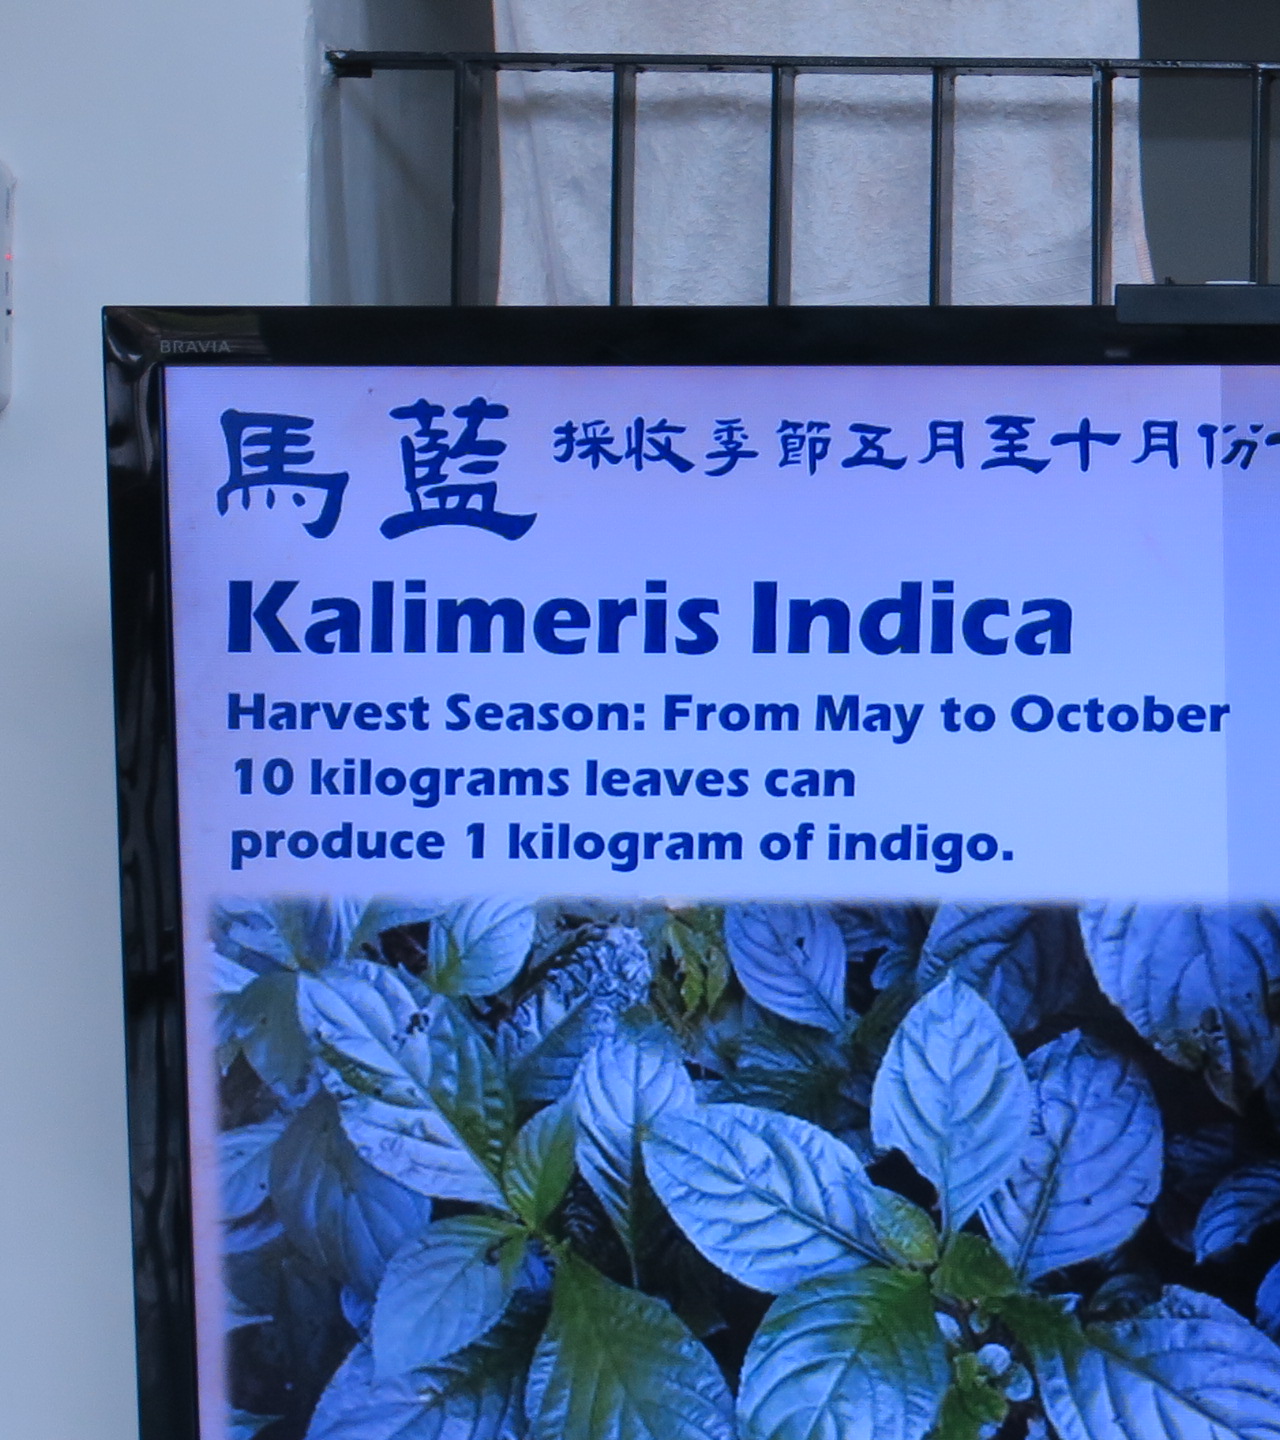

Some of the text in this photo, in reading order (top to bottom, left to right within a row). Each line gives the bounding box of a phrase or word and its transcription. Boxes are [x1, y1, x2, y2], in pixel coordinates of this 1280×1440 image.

[159, 339, 232, 354] BRAVIA
[216, 394, 540, 542] 馬藍
[226, 580, 1074, 657] Kalimeris Indica
[227, 692, 1232, 746] Harvest Season: From May to October
[234, 757, 857, 809] 10 kilograms leaves can
[230, 821, 1015, 875] produce 1 kilogram of indigo.
